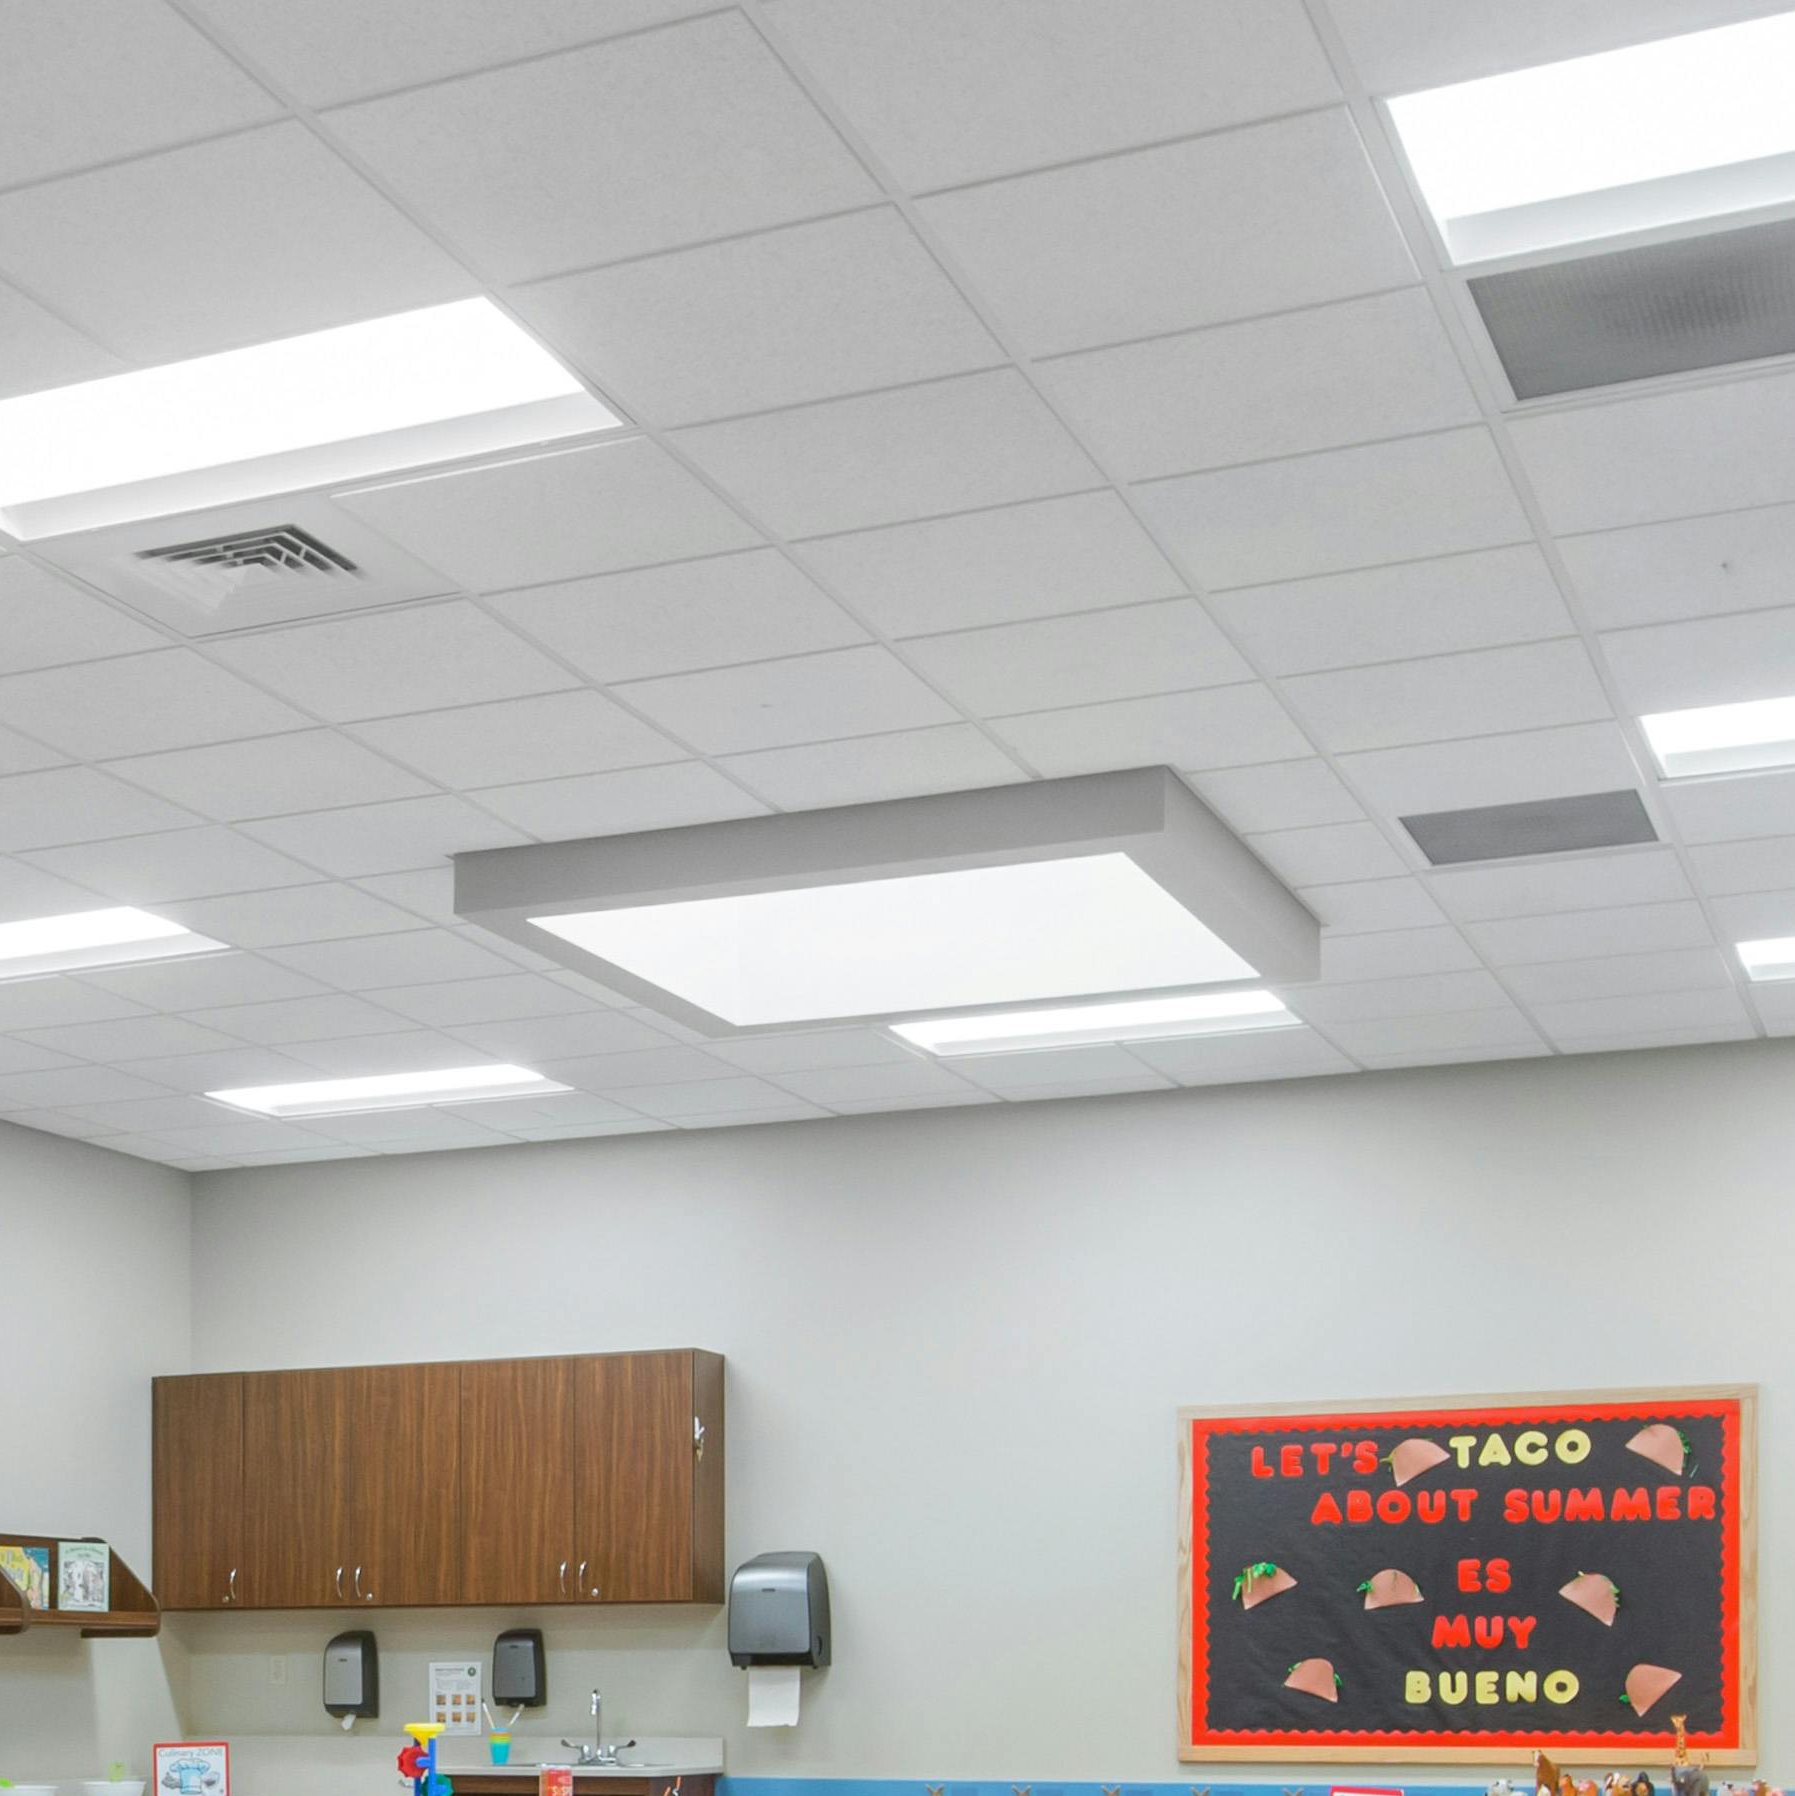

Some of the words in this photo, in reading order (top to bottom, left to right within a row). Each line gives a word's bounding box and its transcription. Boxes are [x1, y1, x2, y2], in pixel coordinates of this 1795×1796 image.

[1252, 1441, 1379, 1478] LET'S
[1449, 1429, 1591, 1468] TACO
[1311, 1489, 1479, 1525] ABOUT
[1504, 1486, 1716, 1523] SUMMER
[1457, 1558, 1511, 1592] ES
[1432, 1615, 1536, 1649] MUY
[1405, 1670, 1579, 1704] BUENO
